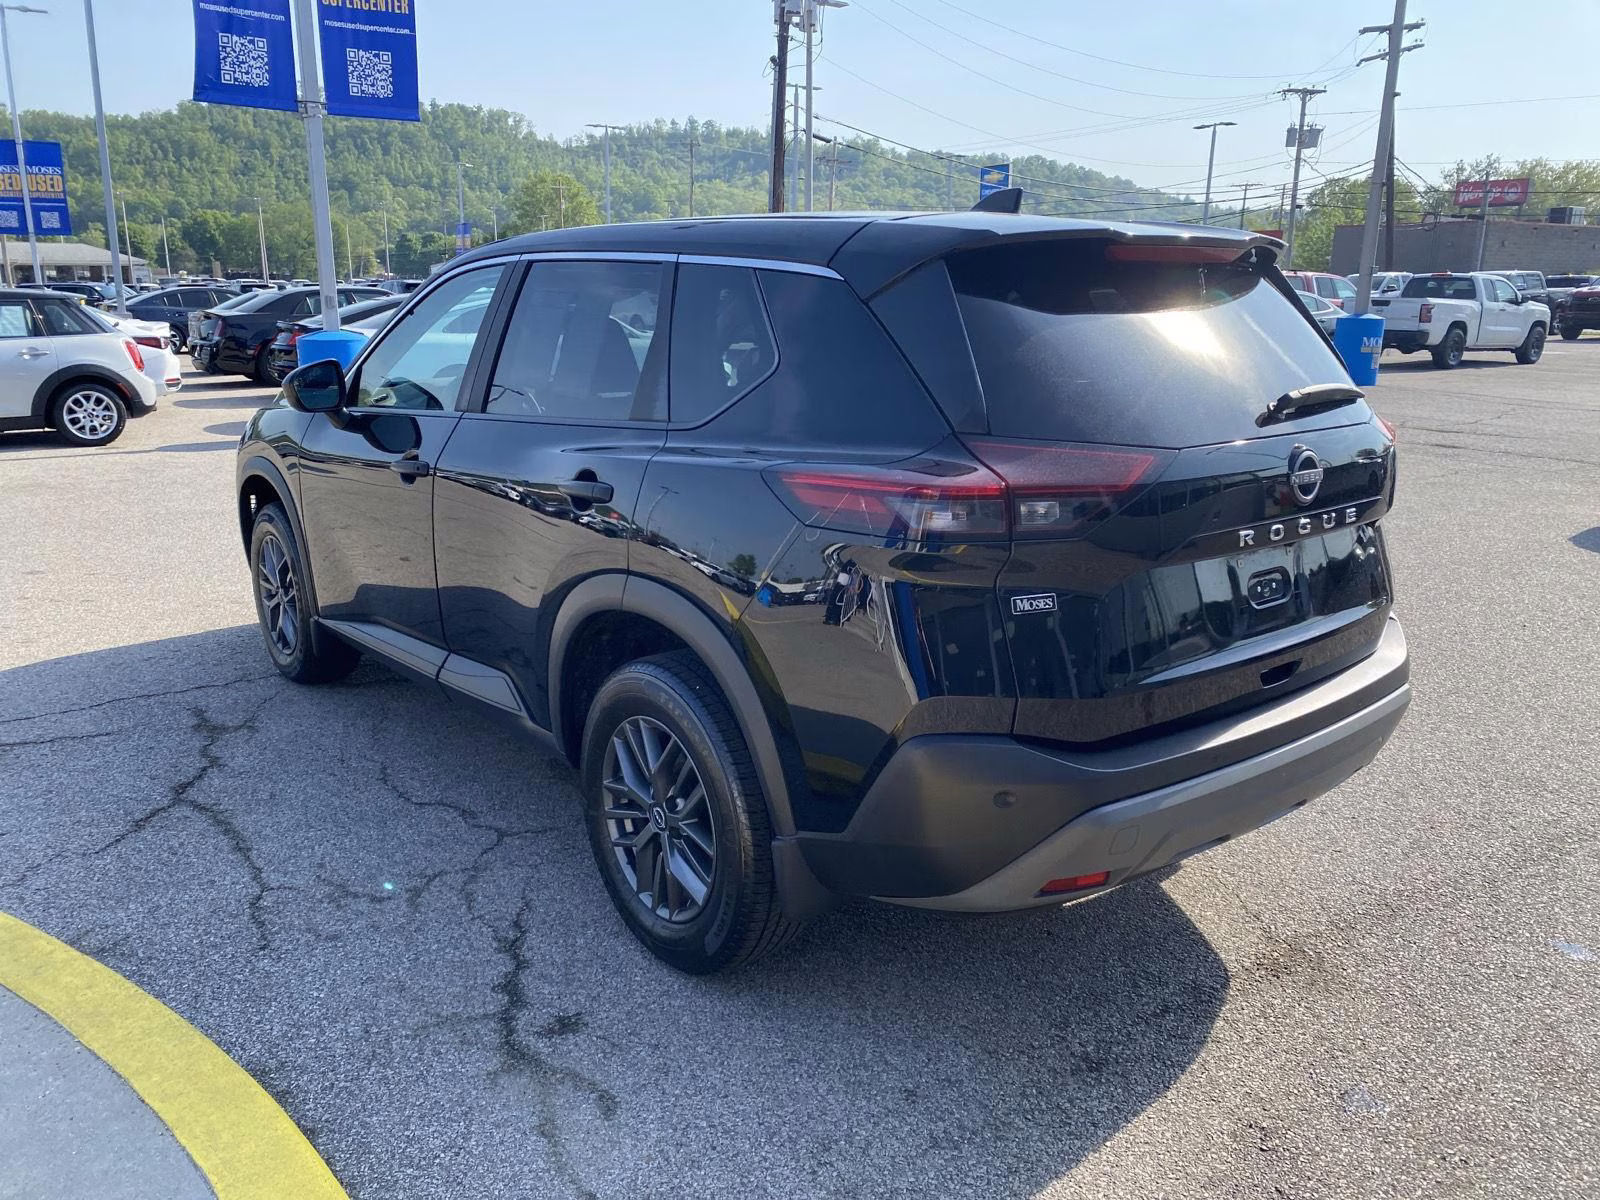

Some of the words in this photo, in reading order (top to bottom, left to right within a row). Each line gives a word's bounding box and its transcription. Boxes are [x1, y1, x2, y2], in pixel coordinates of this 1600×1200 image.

[199, 2, 285, 21] mosesusedsupercenter.com
[322, 0, 409, 14] ERCENTER
[324, 20, 410, 34] mosesusedsupercenter.com
[26, 165, 61, 174] MOSES
[27, 175, 63, 192] USED
[1239, 507, 1358, 547] ROGUE
